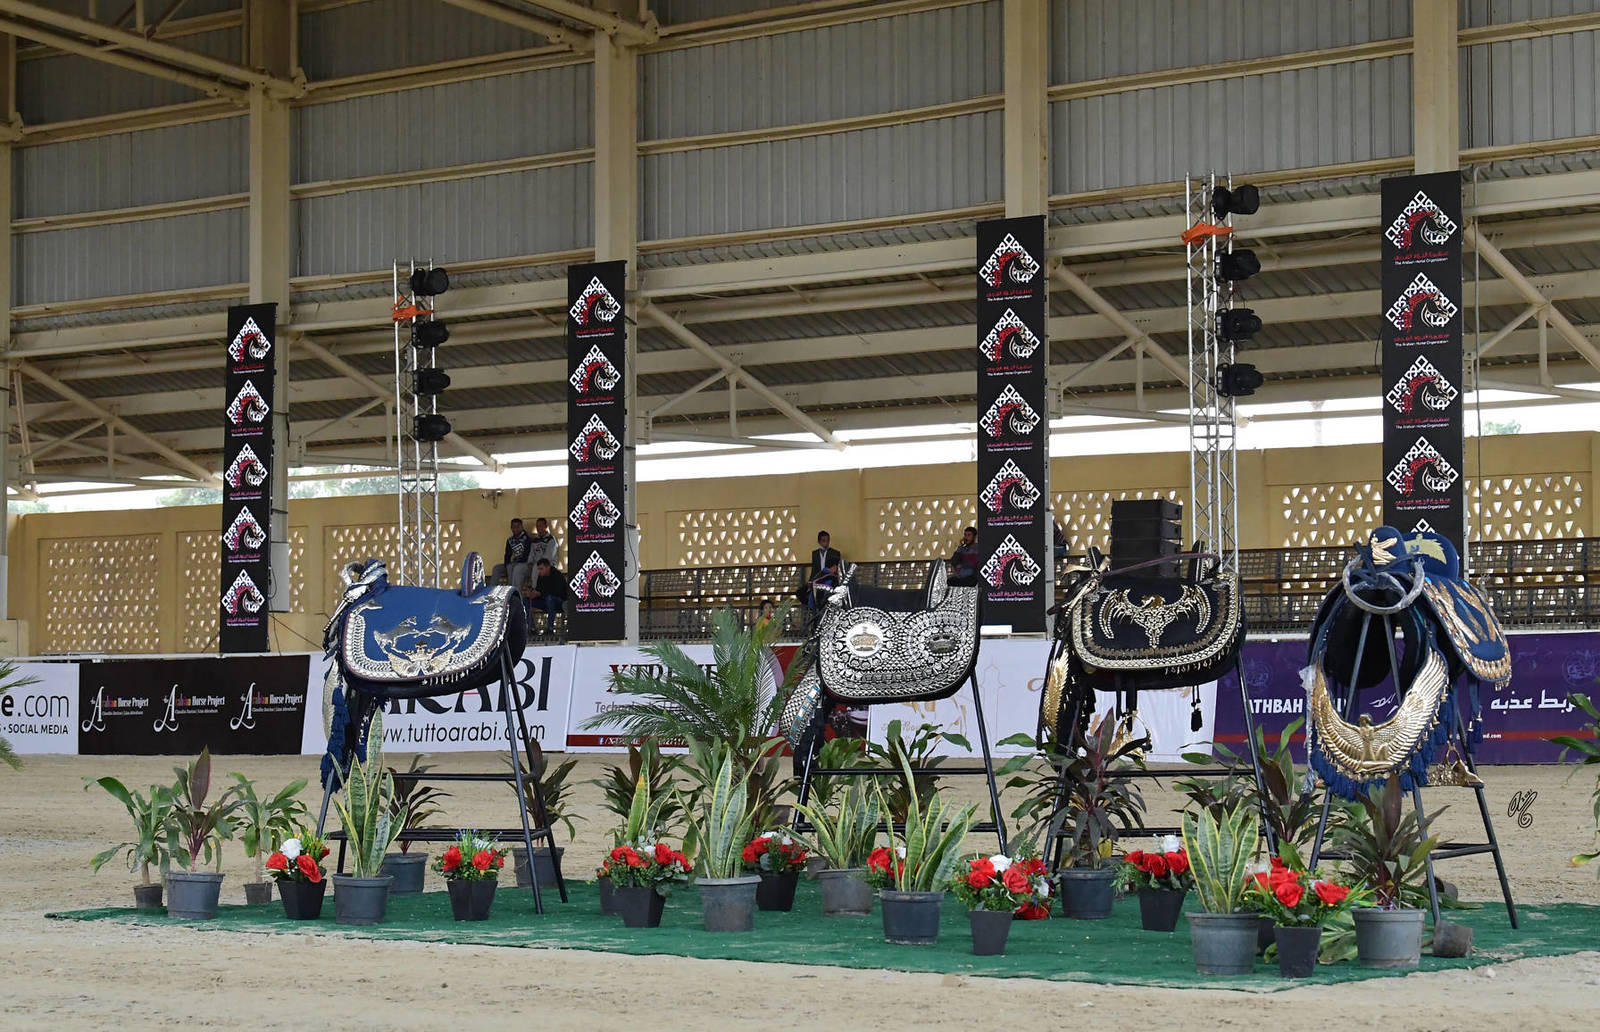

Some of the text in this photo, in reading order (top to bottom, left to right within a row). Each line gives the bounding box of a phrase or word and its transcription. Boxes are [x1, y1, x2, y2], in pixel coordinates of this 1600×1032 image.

[131, 697, 149, 709] Project
[207, 695, 225, 707] Project
[284, 693, 303, 706] Project
[8, 723, 38, 734] SOCIAL
[40, 724, 69, 735] MEDIA
